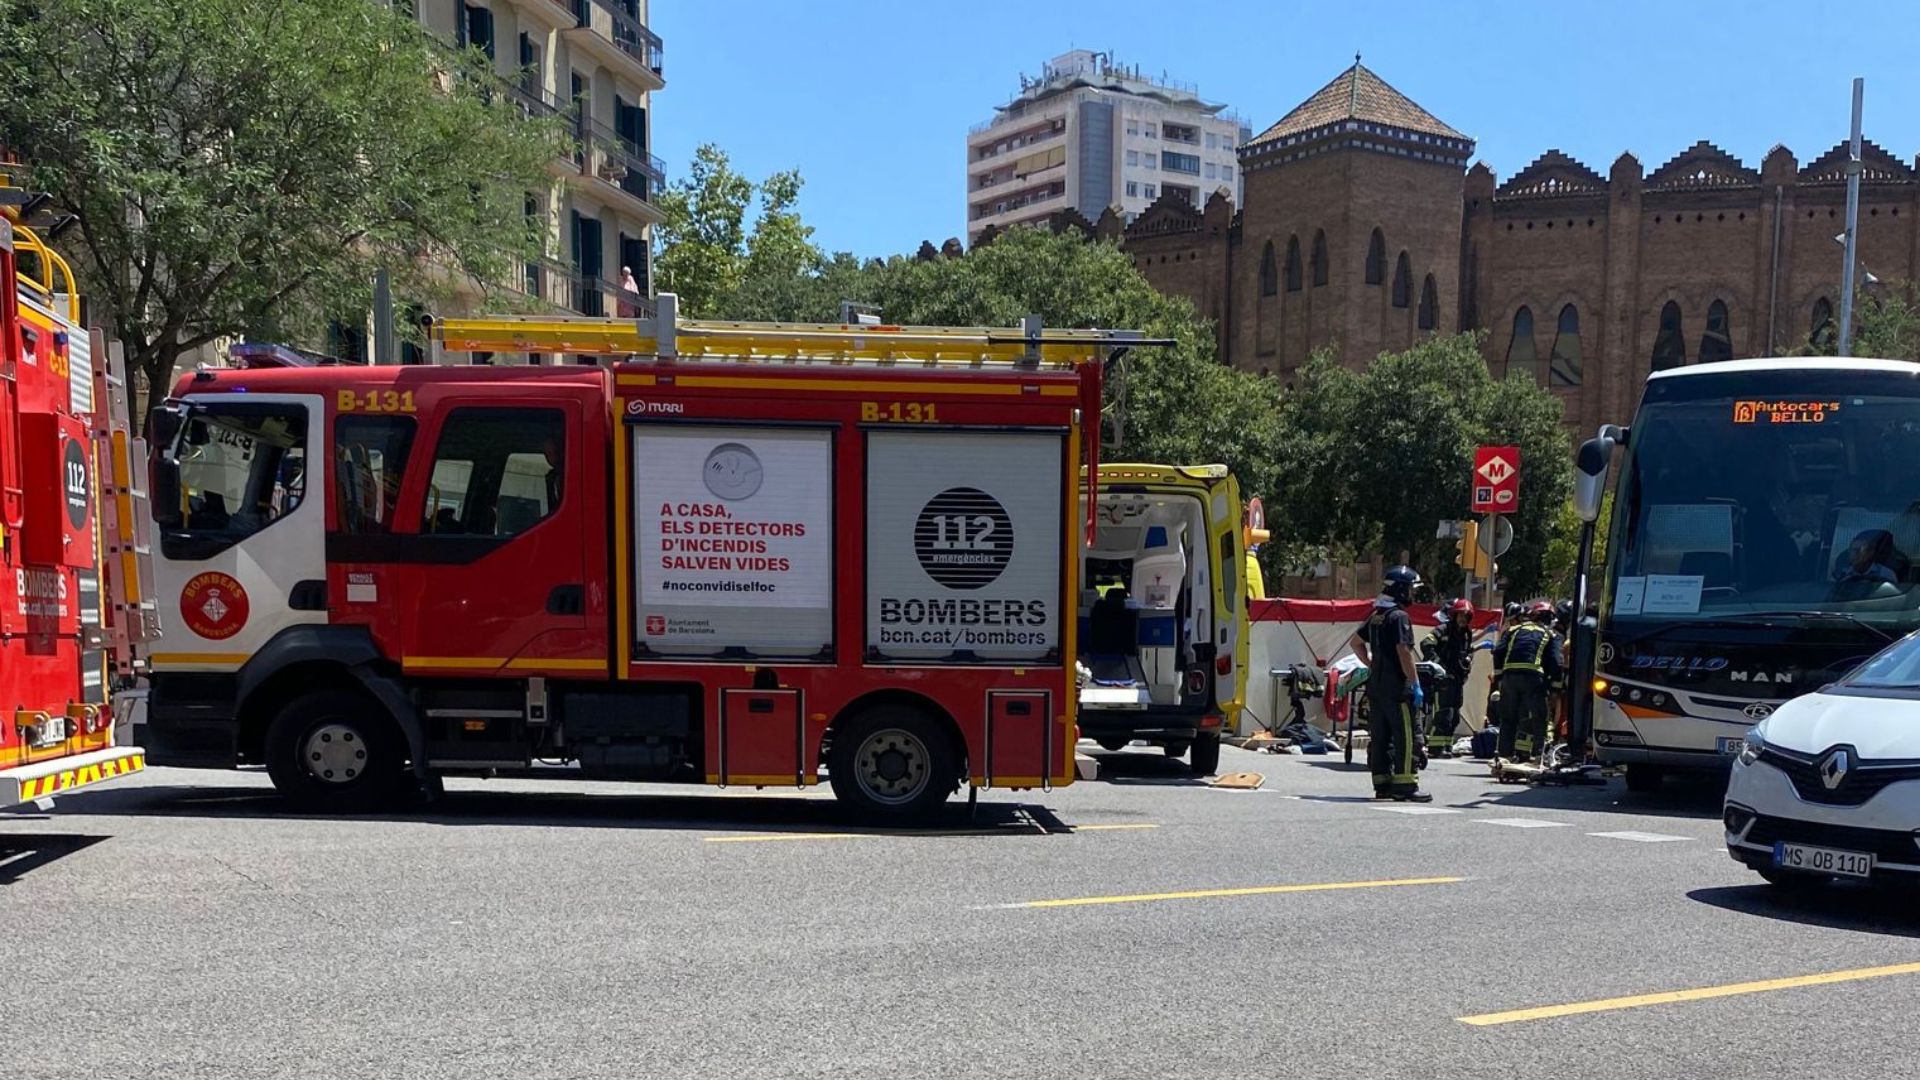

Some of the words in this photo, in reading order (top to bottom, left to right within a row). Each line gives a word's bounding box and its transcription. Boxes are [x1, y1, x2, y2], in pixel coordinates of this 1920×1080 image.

[337, 389, 417, 412] B-131
[648, 403, 683, 413] ITURRI
[1756, 401, 1840, 412] Autocars
[861, 401, 939, 423] B-131
[1771, 412, 1824, 422] BELLO
[68, 461, 86, 495] 112
[1488, 463, 1505, 477] M
[660, 503, 673, 516] A
[677, 504, 732, 519] CASA,
[661, 521, 694, 534] ELS
[699, 523, 805, 536] DETECTORS
[932, 516, 995, 550] 112
[661, 538, 767, 553] D'INCENDIS
[661, 556, 731, 570] SALVEN
[736, 558, 790, 571] VIDES
[16, 568, 67, 600] BOMBERS
[184, 574, 243, 599] BOMBERS
[662, 580, 776, 593] #noconvidiselfoc
[880, 598, 1046, 626] BOMBERS
[880, 627, 1046, 647] bcn.cat/bombers
[1731, 671, 1792, 683] MAN
[1783, 847, 1803, 866] MS
[1837, 854, 1868, 875] 110
